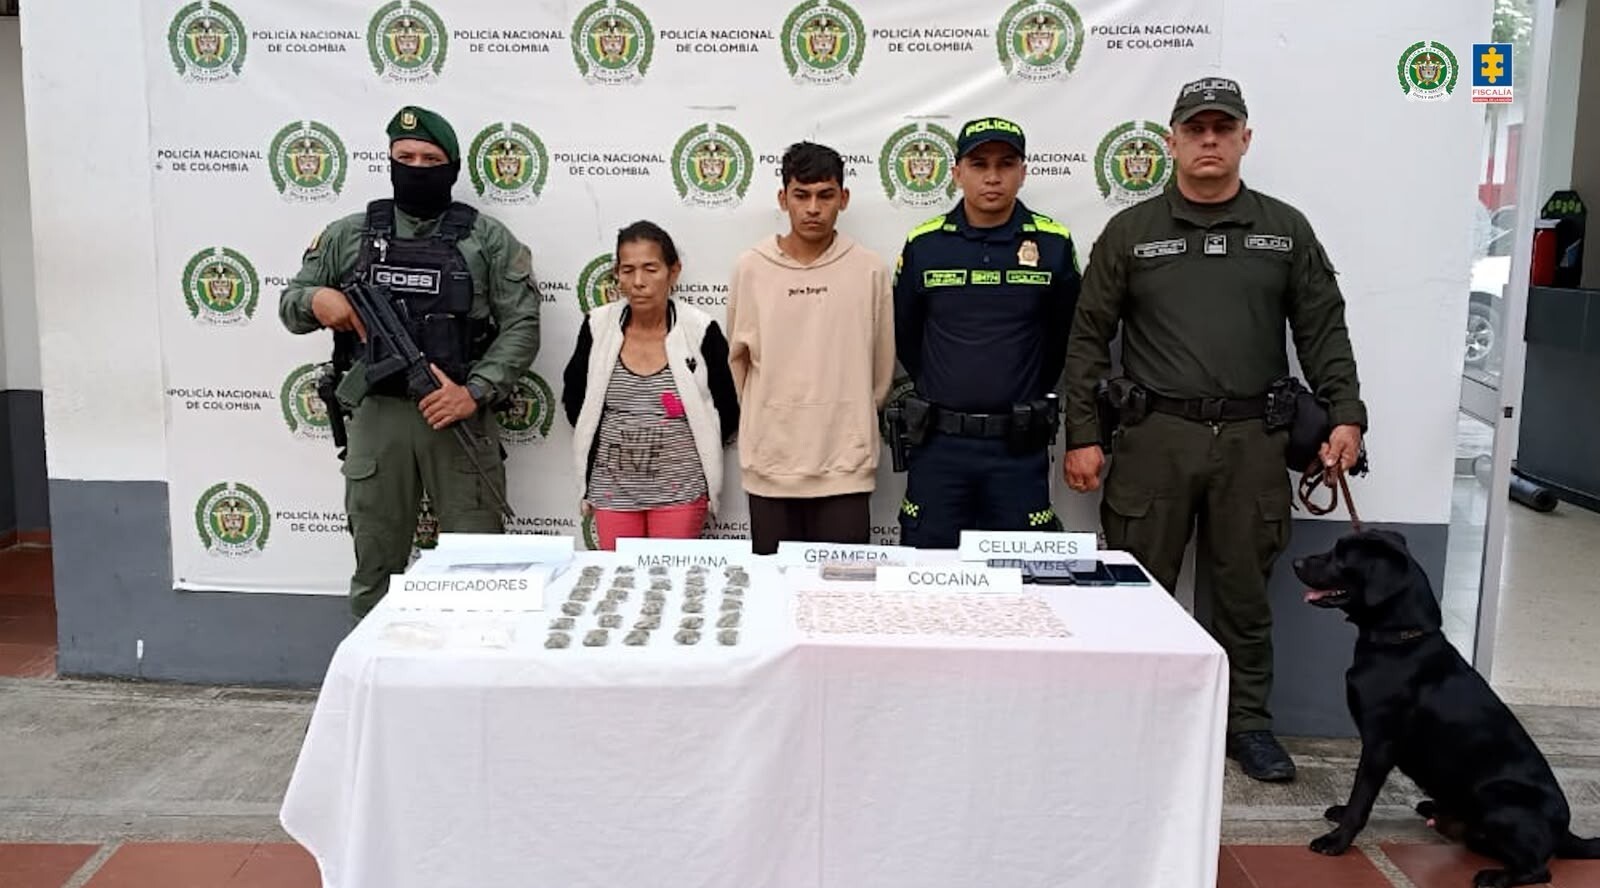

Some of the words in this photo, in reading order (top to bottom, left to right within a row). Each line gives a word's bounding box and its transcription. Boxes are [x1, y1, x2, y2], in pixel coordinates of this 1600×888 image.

[503, 30, 565, 39] NACIONAL
[710, 30, 774, 39] NACIONAL
[924, 28, 990, 38] NACIONAL
[1145, 24, 1211, 35] NACIONAL
[300, 30, 361, 40] NACIONAL
[268, 43, 282, 52] DE
[286, 43, 346, 52] COLOMBIA
[470, 44, 484, 52] DE
[487, 44, 549, 52] COLOMBIA
[676, 43, 691, 52] DE
[694, 43, 759, 52] COLOMBIA
[888, 42, 904, 52] DE
[907, 42, 973, 51] COLOMBIA
[1107, 39, 1123, 49] DE
[1127, 38, 1194, 48] COLOMBIA
[204, 150, 262, 160] NACIONAL
[353, 152, 390, 160] POLIC
[603, 153, 665, 163] NACIONAL
[840, 155, 873, 164] ONAL
[172, 163, 186, 171] DE
[190, 163, 248, 172] COLOMBIA
[569, 166, 584, 175] DE
[588, 166, 650, 175] COLOMBIA
[376, 271, 433, 287] GOES
[539, 281, 571, 291] ONAL
[217, 389, 275, 399] NACIONAL
[186, 401, 199, 410] DE
[203, 401, 261, 411] COLOMBIA
[517, 517, 576, 527] NACIONAL
[291, 523, 305, 532] DE
[308, 523, 350, 532] COLOM
[978, 539, 1078, 555] CELULARES
[908, 571, 990, 587] COCAÍNA
[403, 578, 528, 592] DOCIFICADORES
